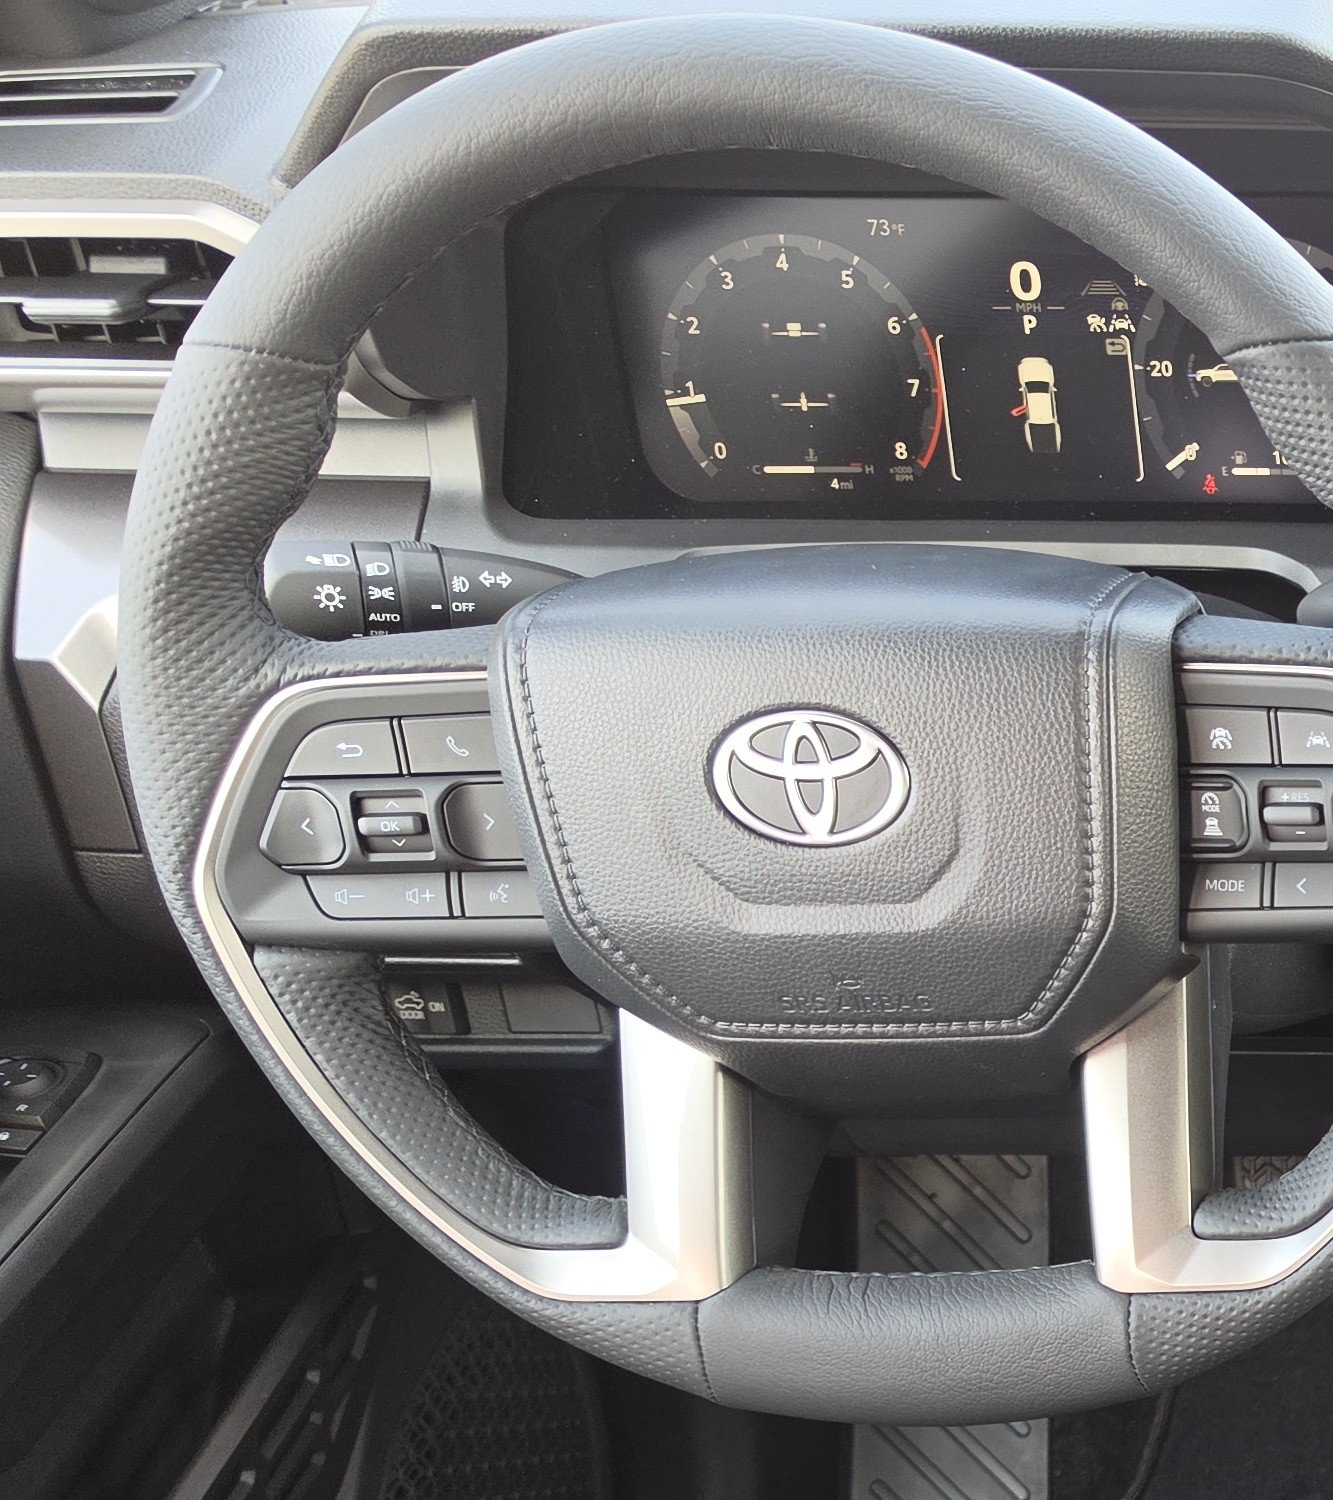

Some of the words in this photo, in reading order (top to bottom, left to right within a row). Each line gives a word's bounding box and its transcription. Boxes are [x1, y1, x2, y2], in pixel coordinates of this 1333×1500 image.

[776, 253, 789, 271] 4
[721, 271, 734, 290] 3
[841, 270, 854, 289] 5
[1009, 261, 1042, 301] 0
[1015, 303, 1042, 313] MPH
[686, 316, 700, 335] 2
[887, 316, 901, 335] 6
[1023, 315, 1037, 334] P
[1149, 361, 1173, 378] 20
[685, 381, 695, 398] 1
[907, 378, 920, 397] 7
[714, 442, 727, 459] 0
[895, 441, 908, 460] 8
[865, 465, 875, 475] H
[451, 602, 476, 612] OFF
[368, 613, 401, 622] AUTO
[1202, 805, 1220, 813] MODE
[380, 821, 400, 831] OK
[1205, 879, 1245, 892] MODE
[428, 1001, 445, 1012] ON
